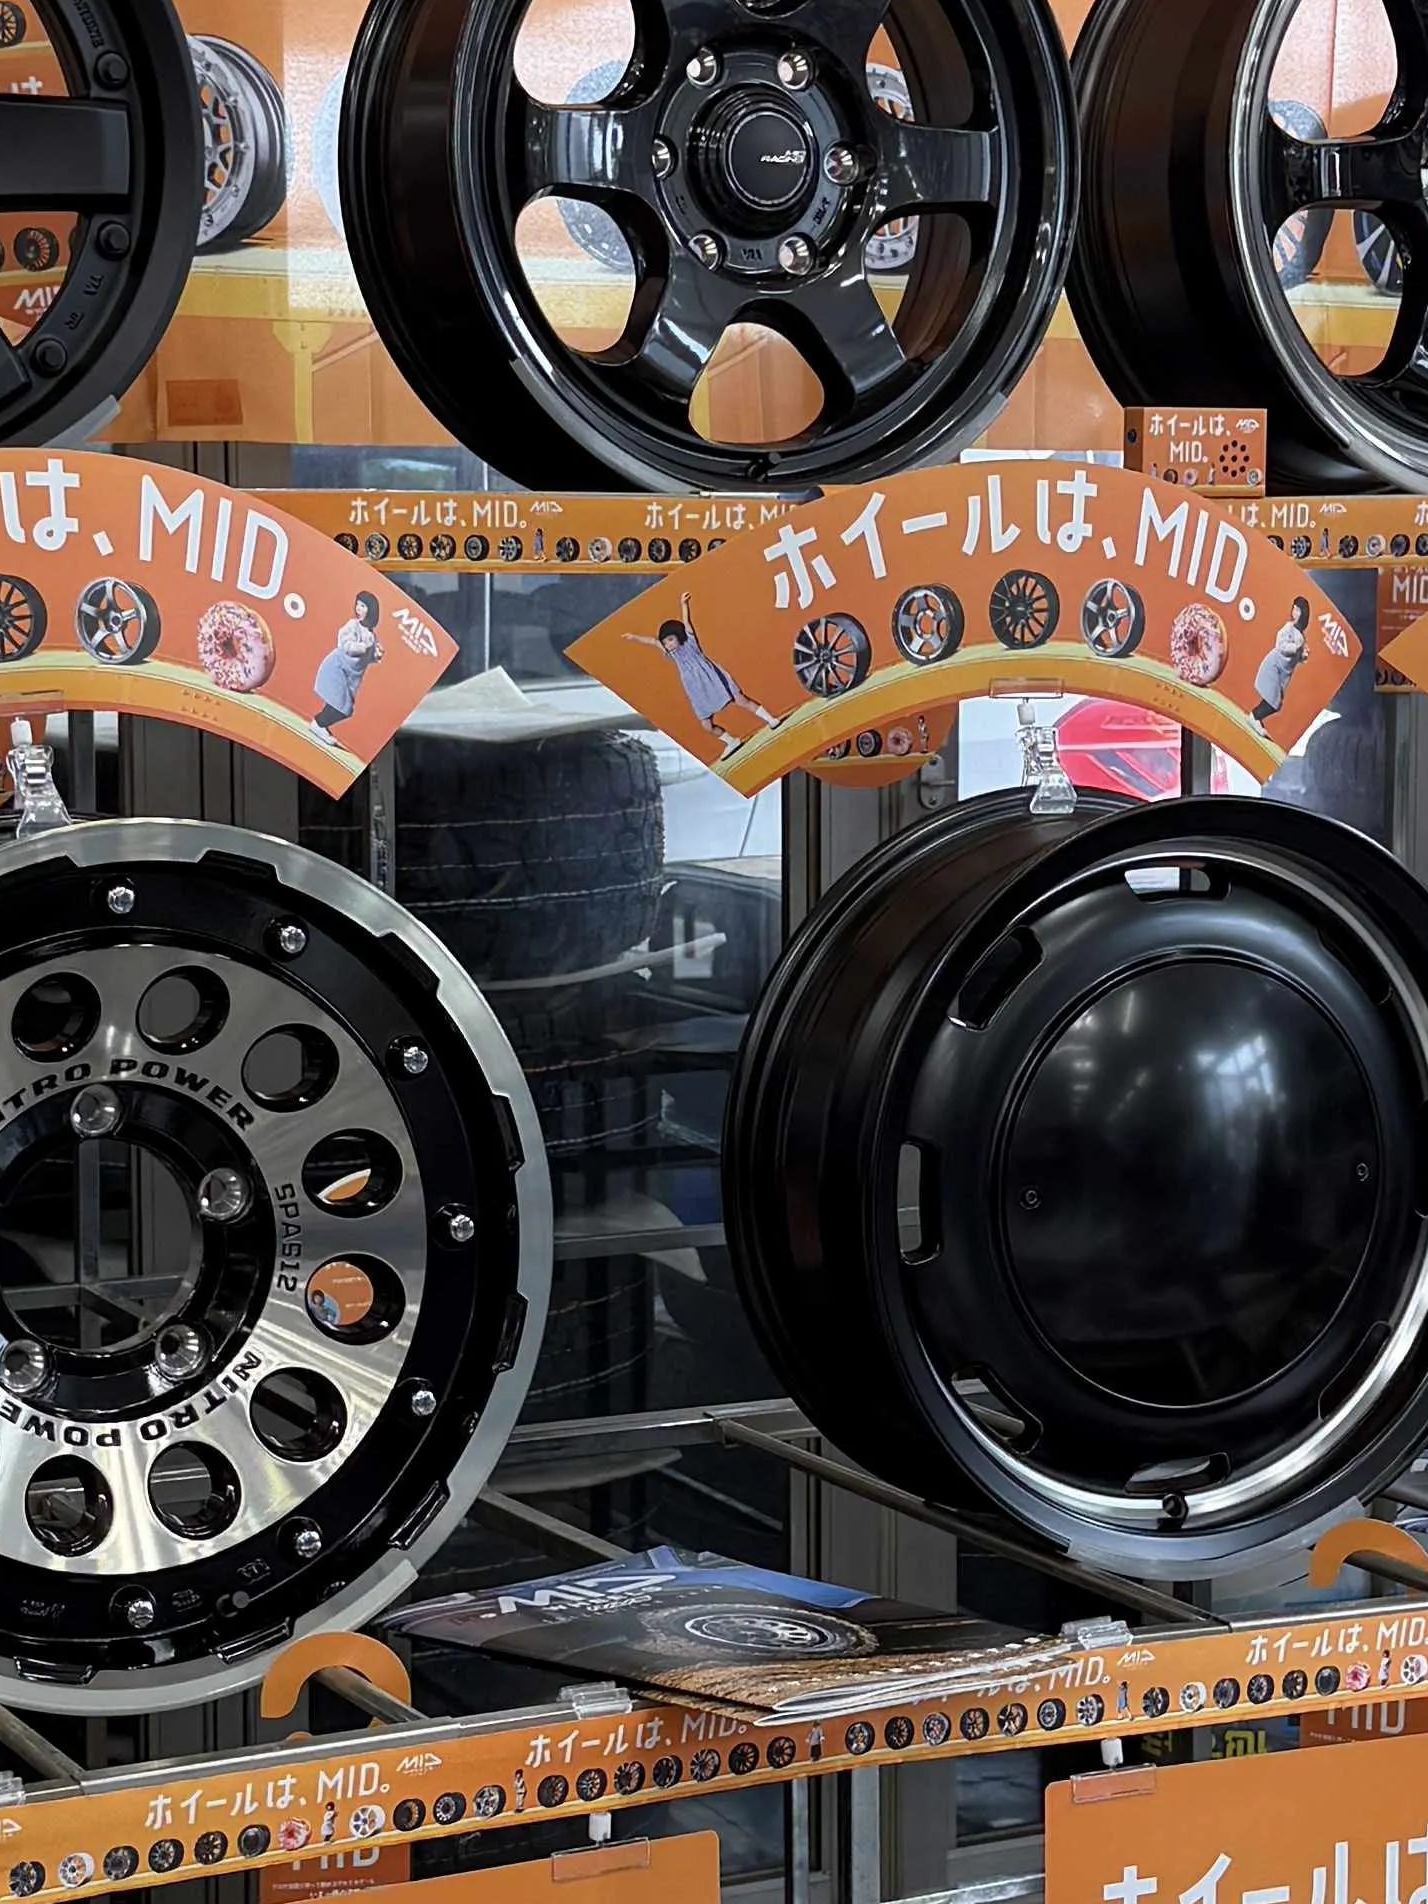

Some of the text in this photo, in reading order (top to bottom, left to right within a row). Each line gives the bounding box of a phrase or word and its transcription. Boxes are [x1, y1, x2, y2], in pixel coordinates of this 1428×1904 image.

[1170, 441, 1209, 464] MID。
[348, 498, 527, 529] ホイールは、MID。
[764, 469, 1256, 622] ホイールは、MID。
[109, 1057, 256, 1132] POWER
[274, 1182, 302, 1294] SPAS12
[139, 1350, 263, 1442] NITRO
[525, 1712, 750, 1770] ホイールは、MID。
[145, 1762, 391, 1832] ホイールは、MID。
